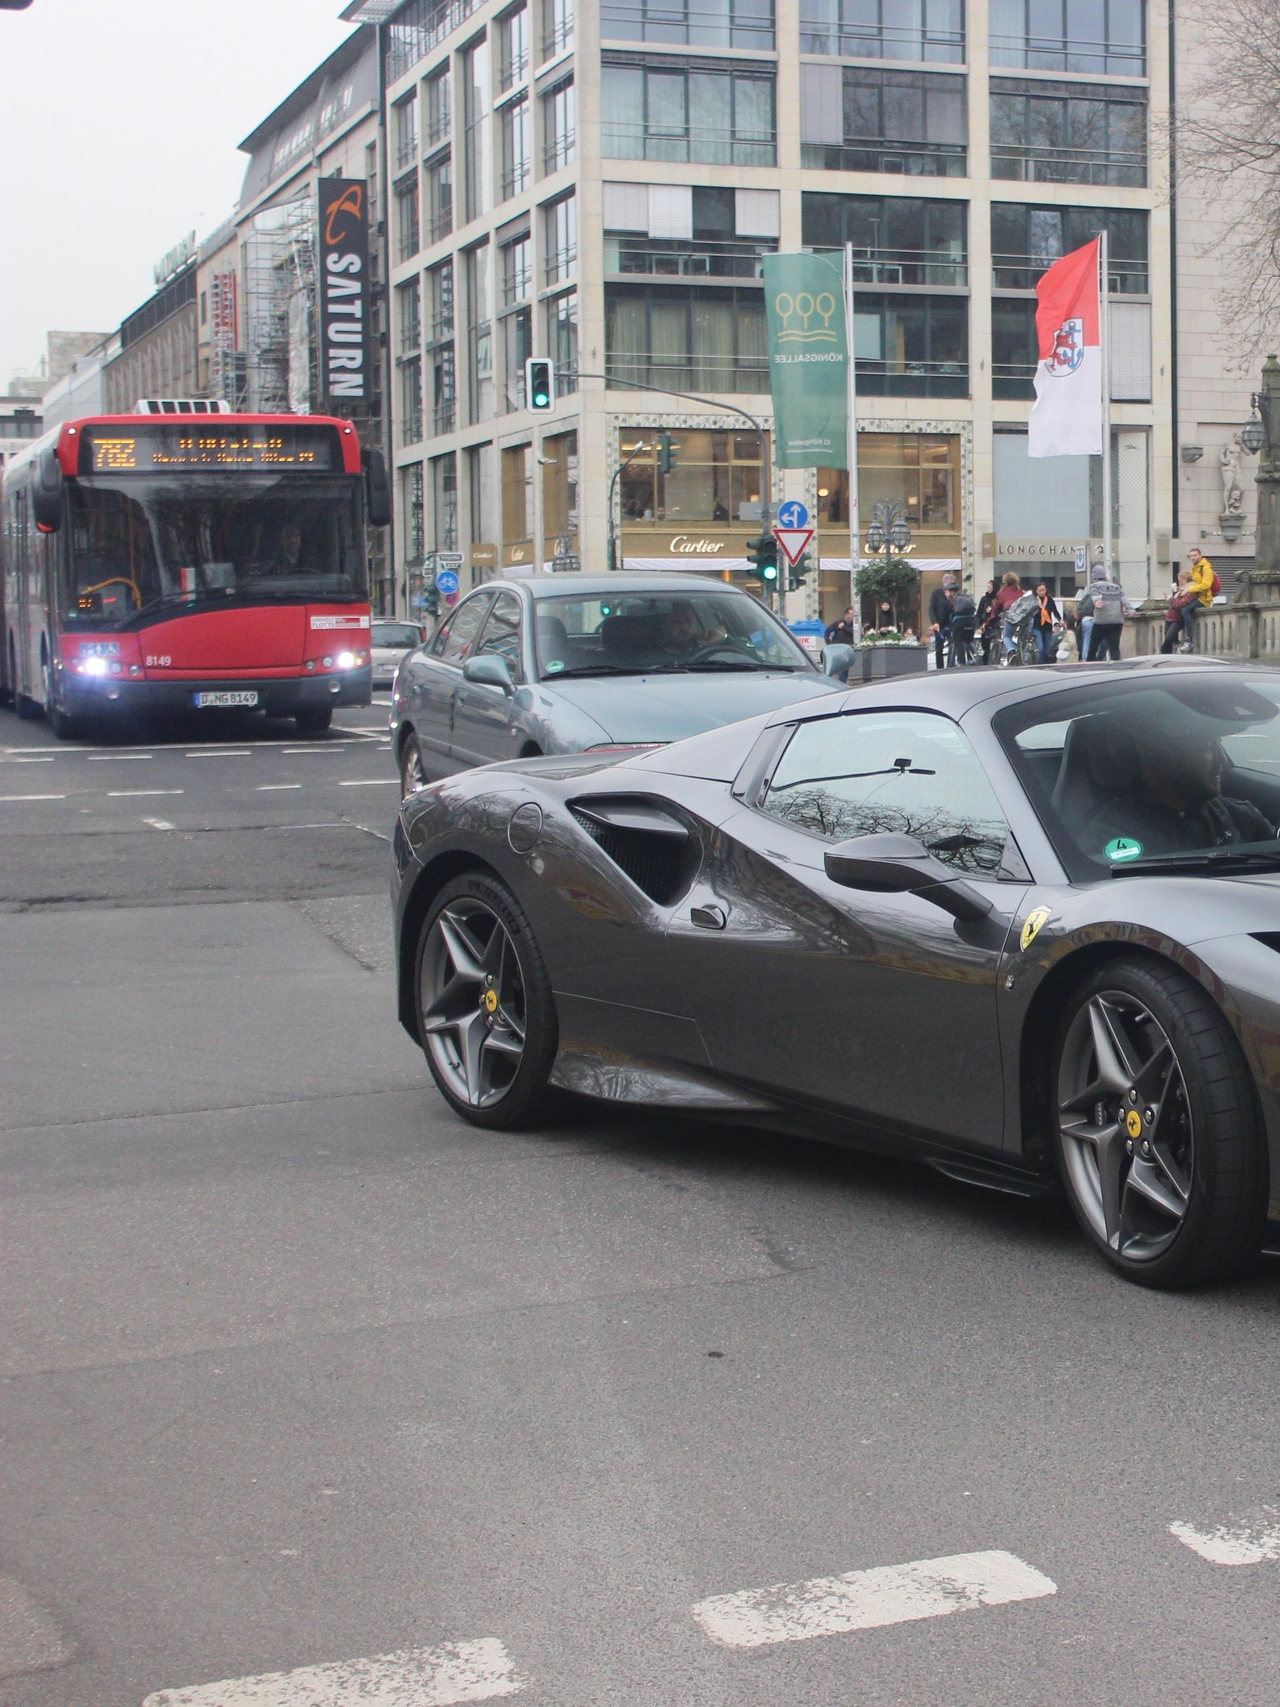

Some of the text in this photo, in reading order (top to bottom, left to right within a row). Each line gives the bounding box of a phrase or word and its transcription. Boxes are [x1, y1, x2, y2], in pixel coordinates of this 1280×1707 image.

[326, 253, 364, 396] SATURN
[669, 536, 724, 553] Cartier
[998, 545, 1077, 555] LONGCHAM
[146, 656, 171, 666] 8149
[230, 693, 256, 703] 8149
[1117, 839, 1127, 849] 4
